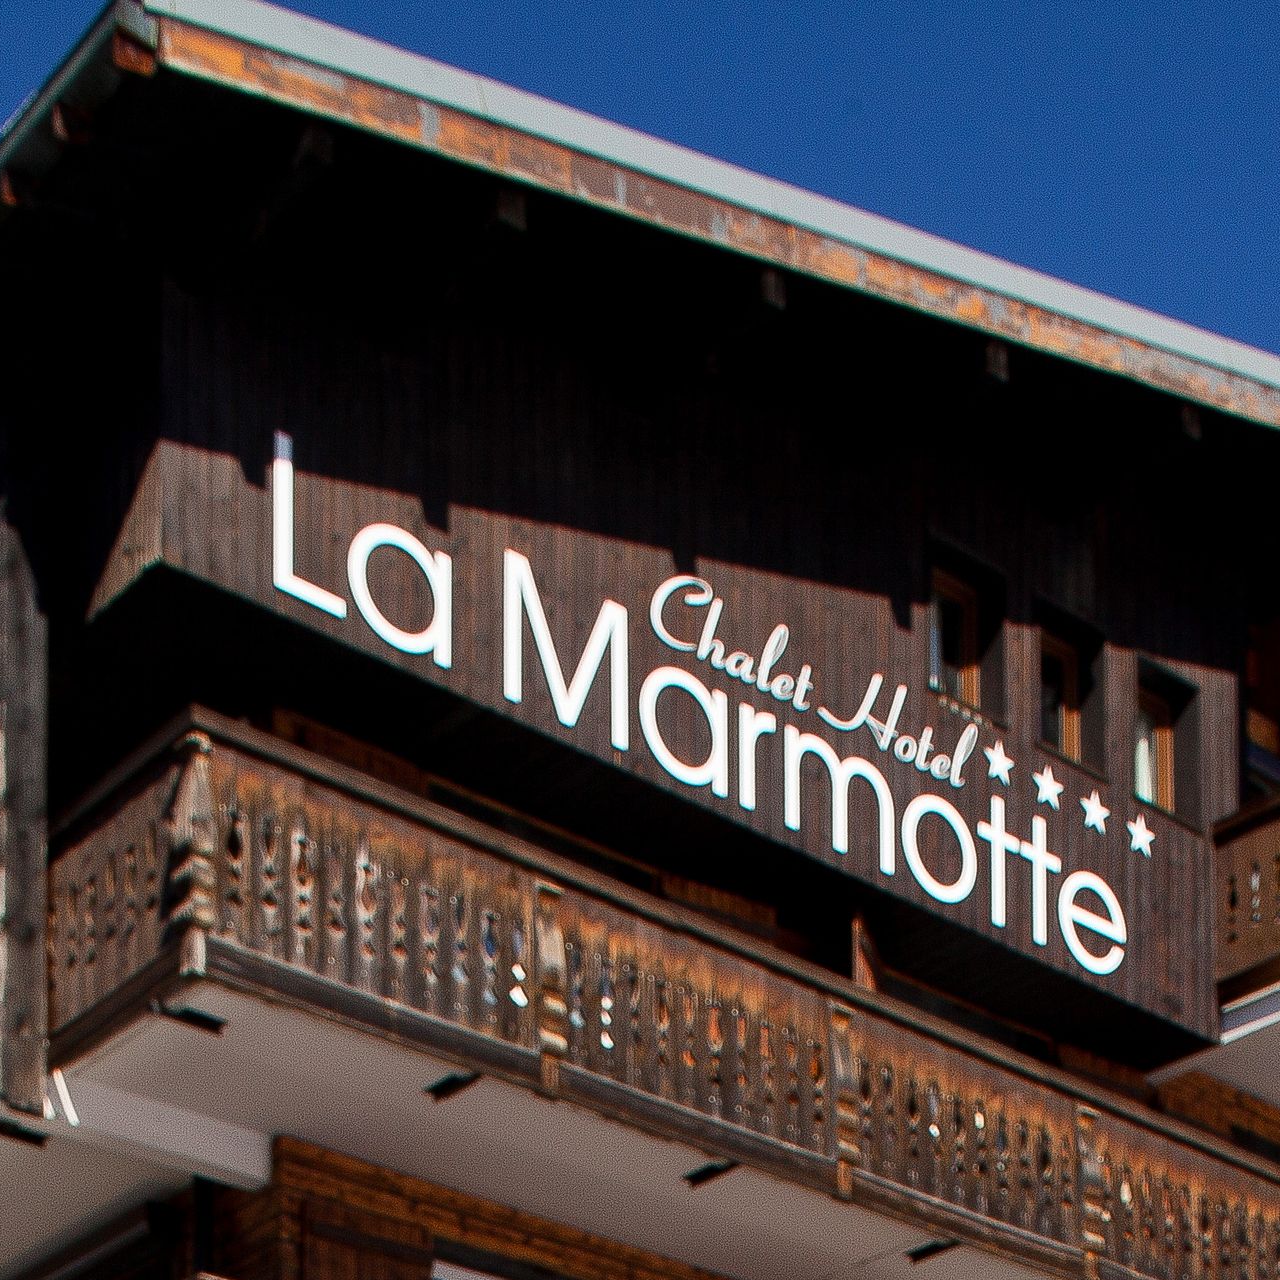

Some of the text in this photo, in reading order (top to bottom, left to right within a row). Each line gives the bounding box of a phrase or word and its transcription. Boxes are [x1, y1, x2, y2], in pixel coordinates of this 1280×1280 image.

[272, 431, 1128, 976] La Marmotte
[650, 575, 979, 787] Chalet Hotel
